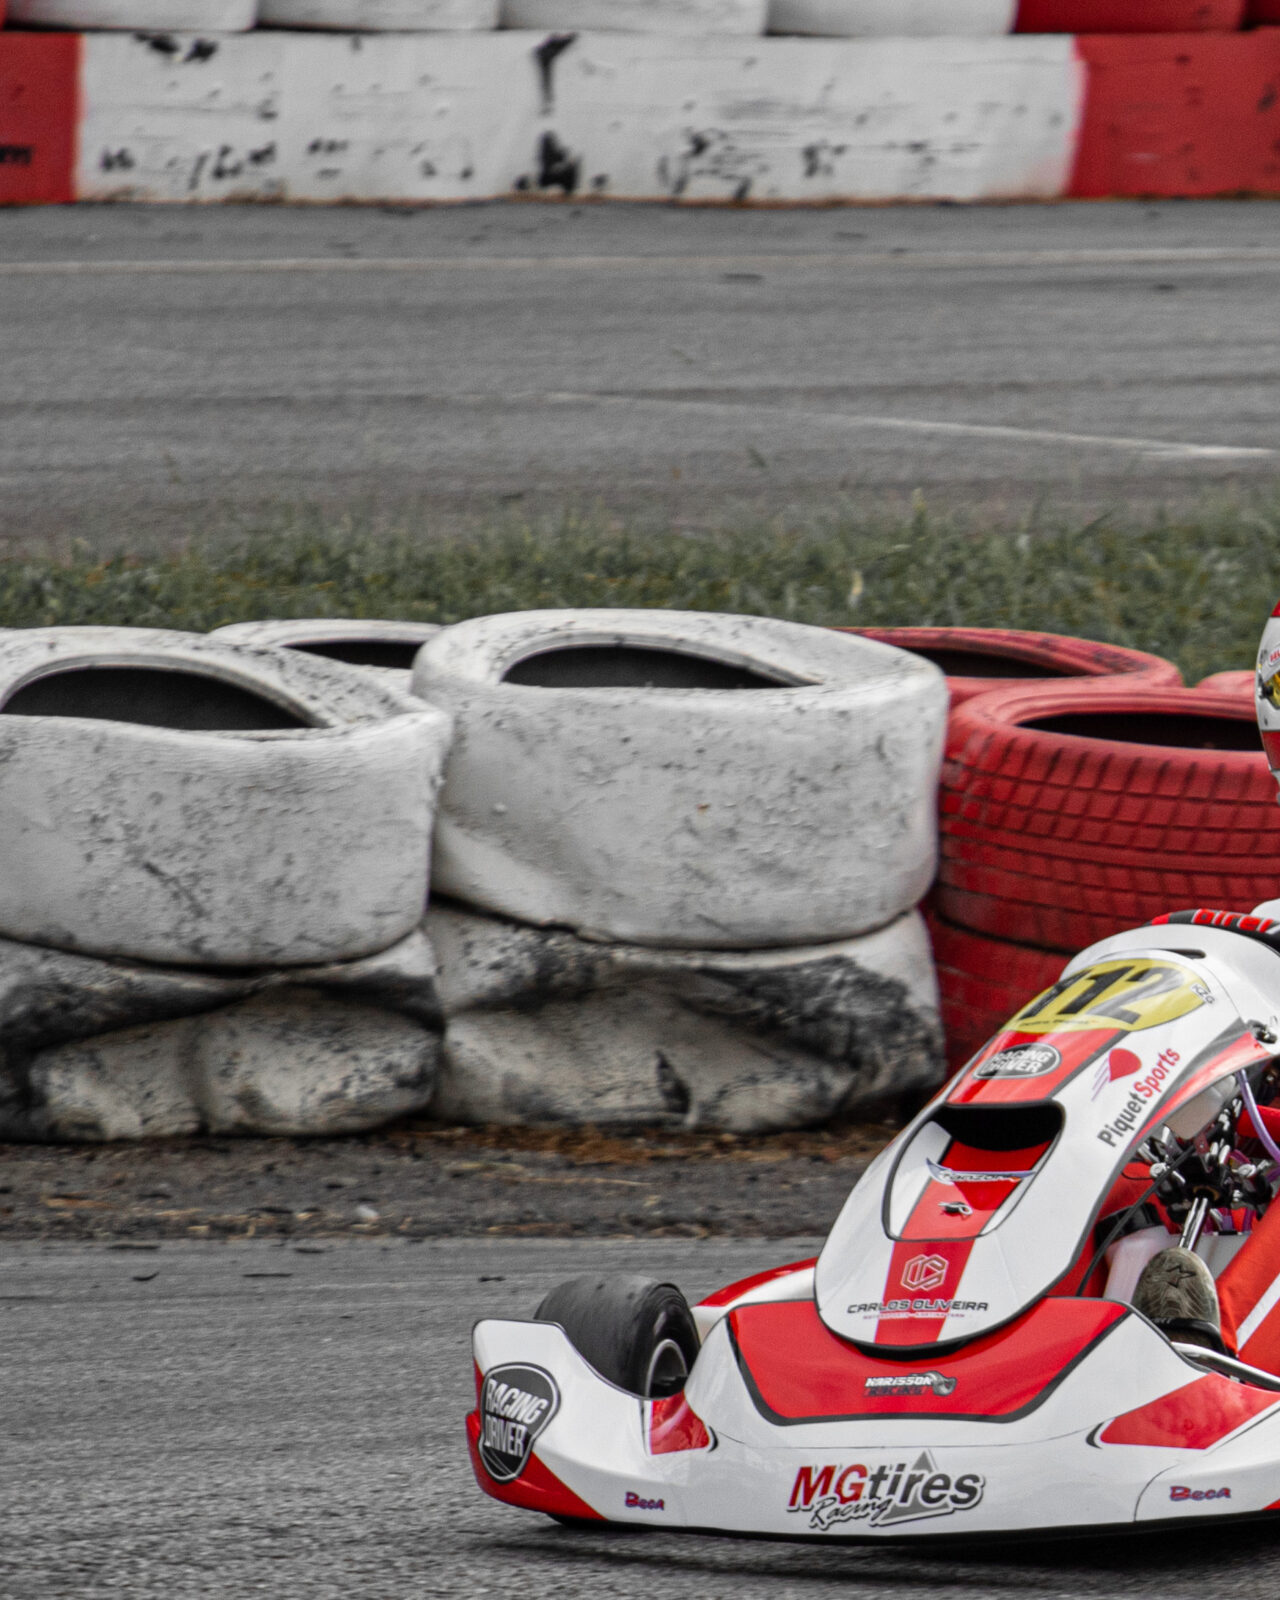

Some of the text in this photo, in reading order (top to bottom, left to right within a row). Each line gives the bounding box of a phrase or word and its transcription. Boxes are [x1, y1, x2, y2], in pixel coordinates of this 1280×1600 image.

[1018, 965, 1185, 1025] 112
[847, 1298, 989, 1314] CARLOS OLIVEIRA
[485, 1378, 550, 1425] RACING
[484, 1413, 528, 1458] DRIVER
[810, 1496, 895, 1526] Racing
